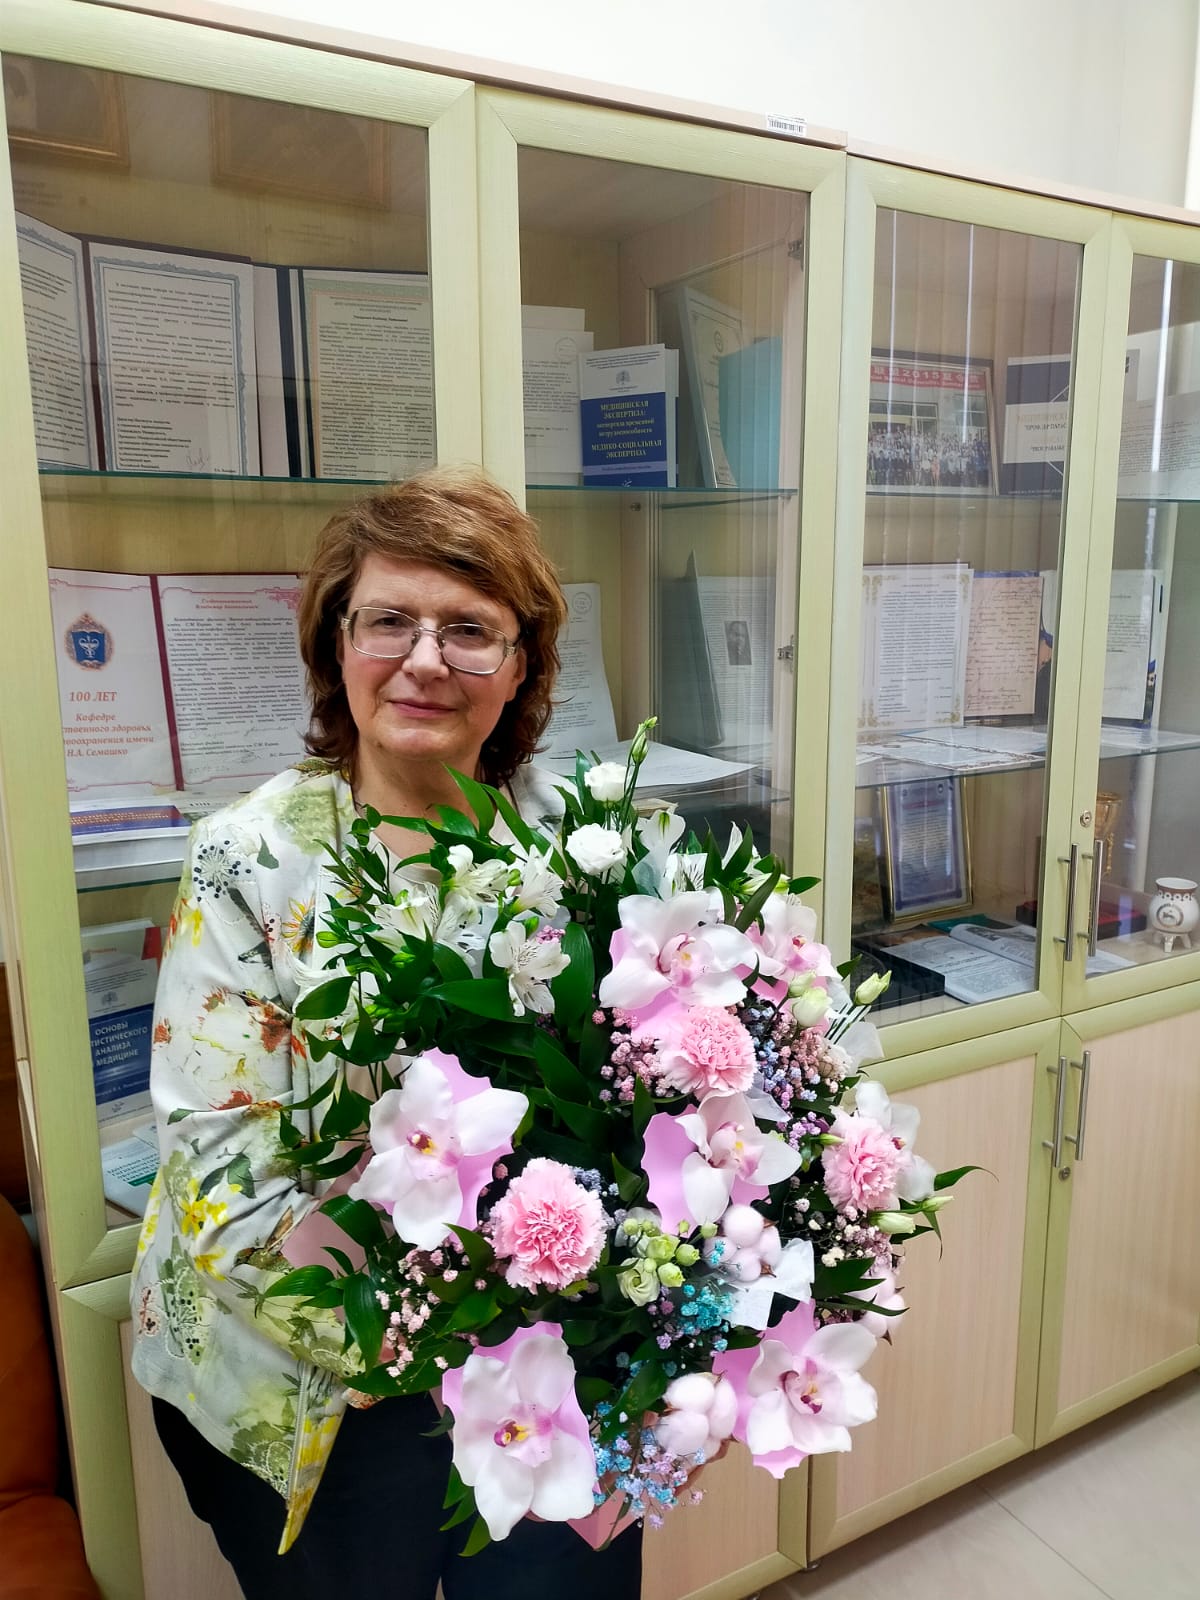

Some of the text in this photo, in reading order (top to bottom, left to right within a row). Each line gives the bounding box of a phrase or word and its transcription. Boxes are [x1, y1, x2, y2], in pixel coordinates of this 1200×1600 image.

[70, 691, 118, 702] 100 ЛЕТ
[76, 713, 117, 723] Кафедре
[112, 724, 152, 734] здоровья
[64, 737, 125, 746] воохранения
[86, 748, 128, 757] Семашко
[95, 1021, 128, 1036] ОСНОВЫ
[96, 1041, 131, 1056] АНАЛИЗА
[96, 1049, 139, 1066] МЕДИЦИНЕ
